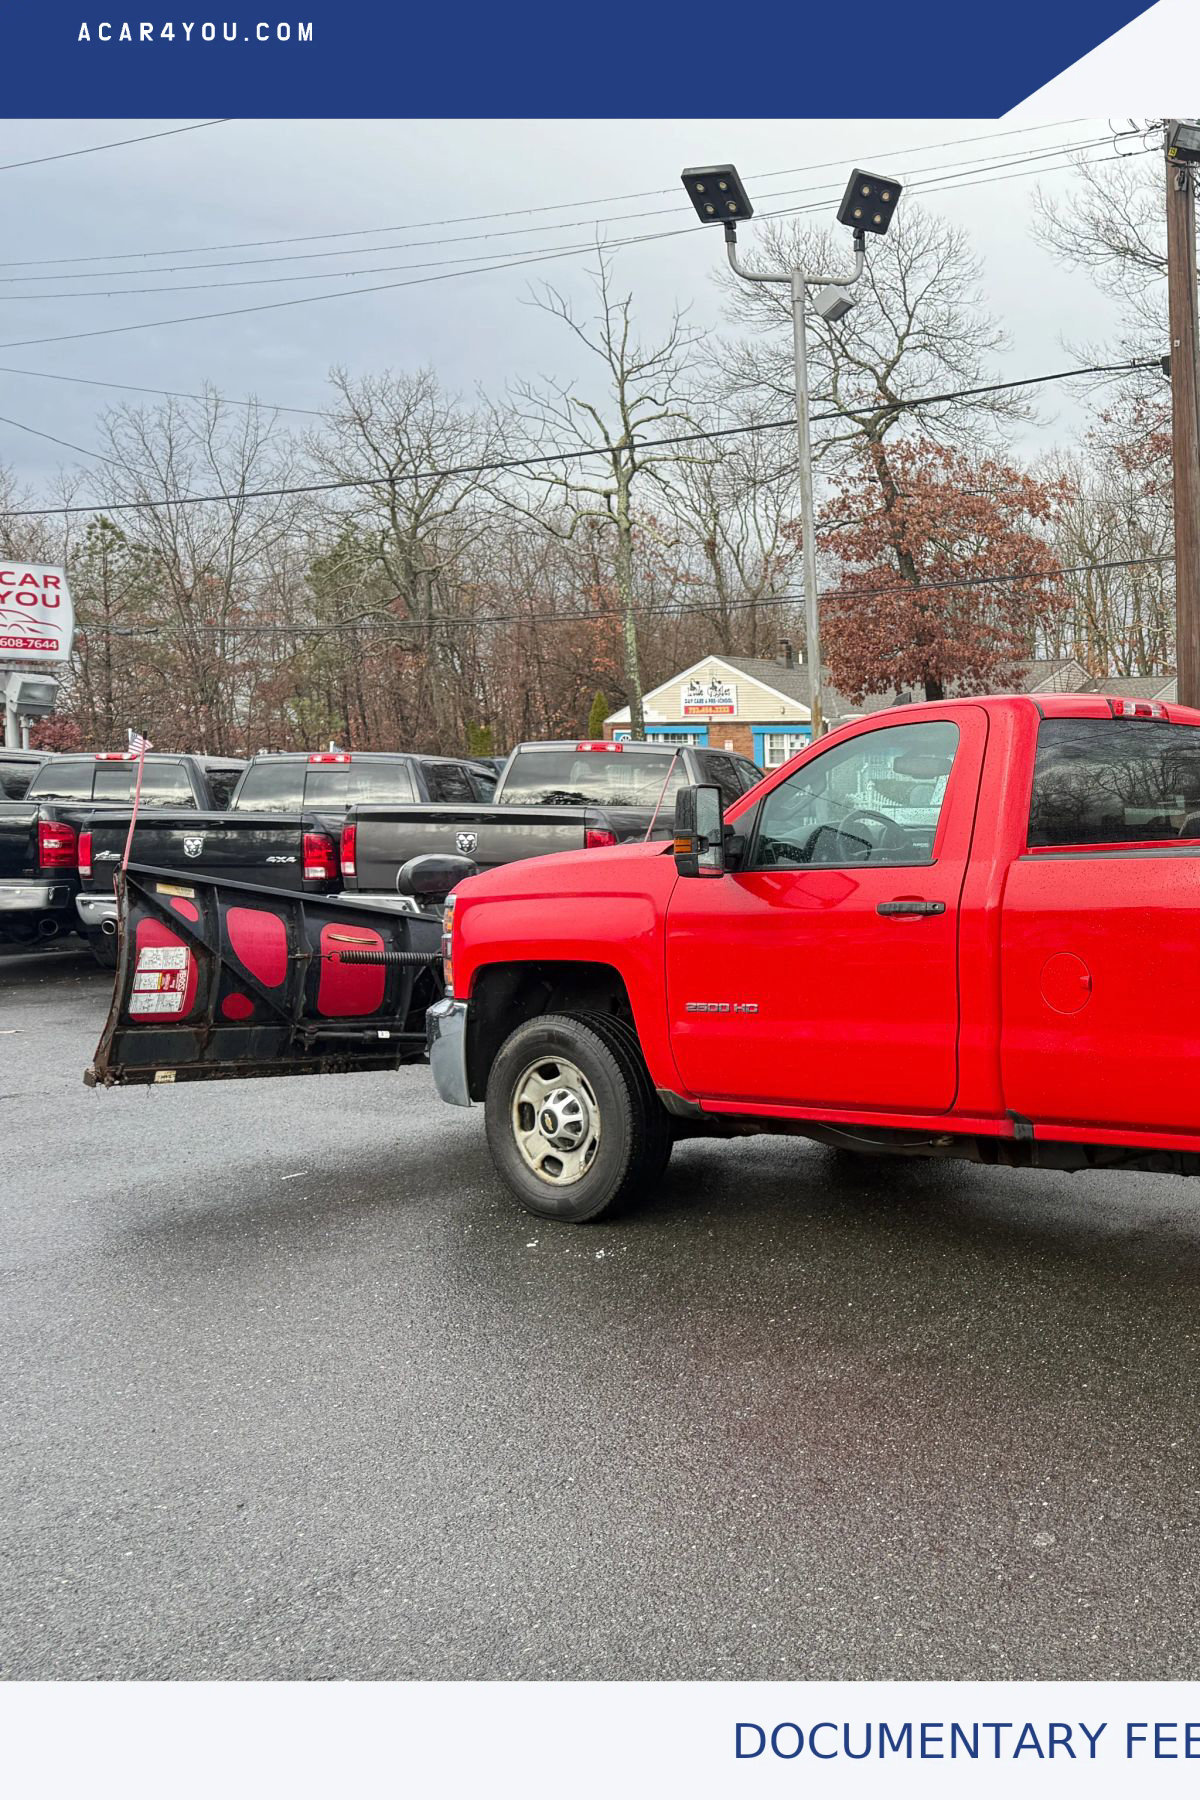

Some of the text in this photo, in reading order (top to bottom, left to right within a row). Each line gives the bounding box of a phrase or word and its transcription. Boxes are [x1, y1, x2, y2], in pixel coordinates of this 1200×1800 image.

[0, 571, 61, 590] CAR
[0, 638, 57, 649] 608-7644
[686, 1002, 730, 1013] 2500
